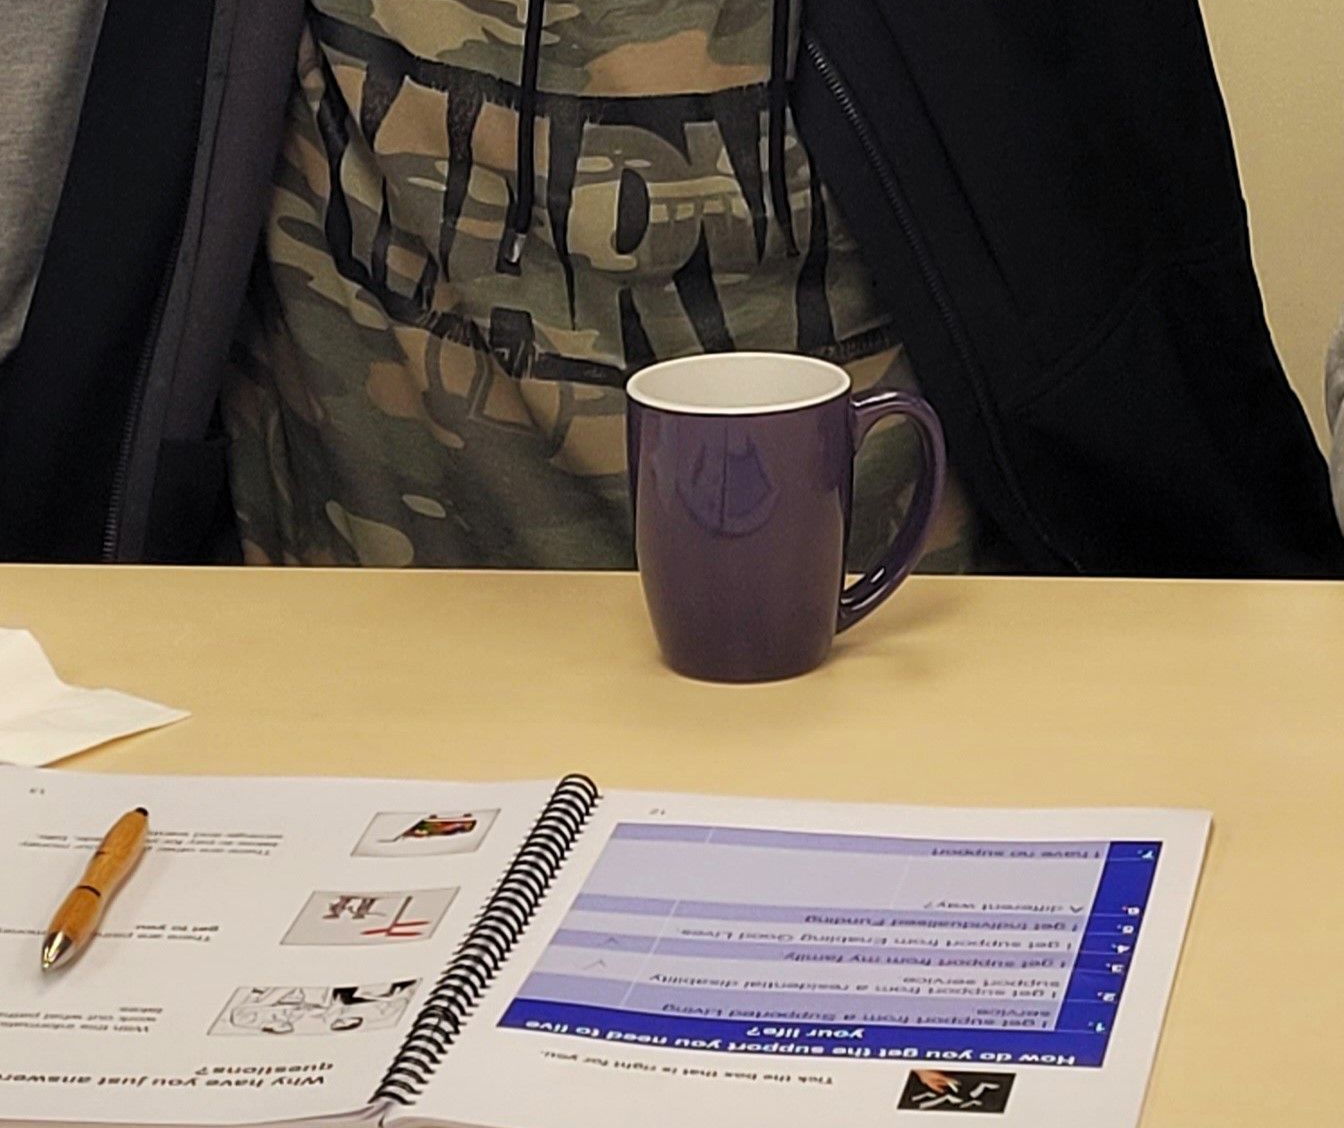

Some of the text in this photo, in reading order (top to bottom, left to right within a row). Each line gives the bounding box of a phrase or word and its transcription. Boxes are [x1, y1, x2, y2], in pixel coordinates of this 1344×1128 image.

[784, 952, 1054, 970] get support from family
[902, 977, 1060, 988] support service
[874, 984, 921, 995] from
[927, 987, 1006, 997] support
[1011, 989, 1045, 998] get
[662, 1003, 1035, 1028] get support from Supported Living
[975, 1008, 1051, 1018] service
[745, 1026, 866, 1040] your life?
[525, 1020, 1076, 1066] How do you get the support you need to live
[193, 1061, 335, 1076] questions?
[614, 1061, 834, 1085] Tick the that right
[97, 1075, 148, 1087] just
[151, 1077, 197, 1087] you
[205, 1079, 265, 1089] have
[271, 1075, 325, 1087] Why
